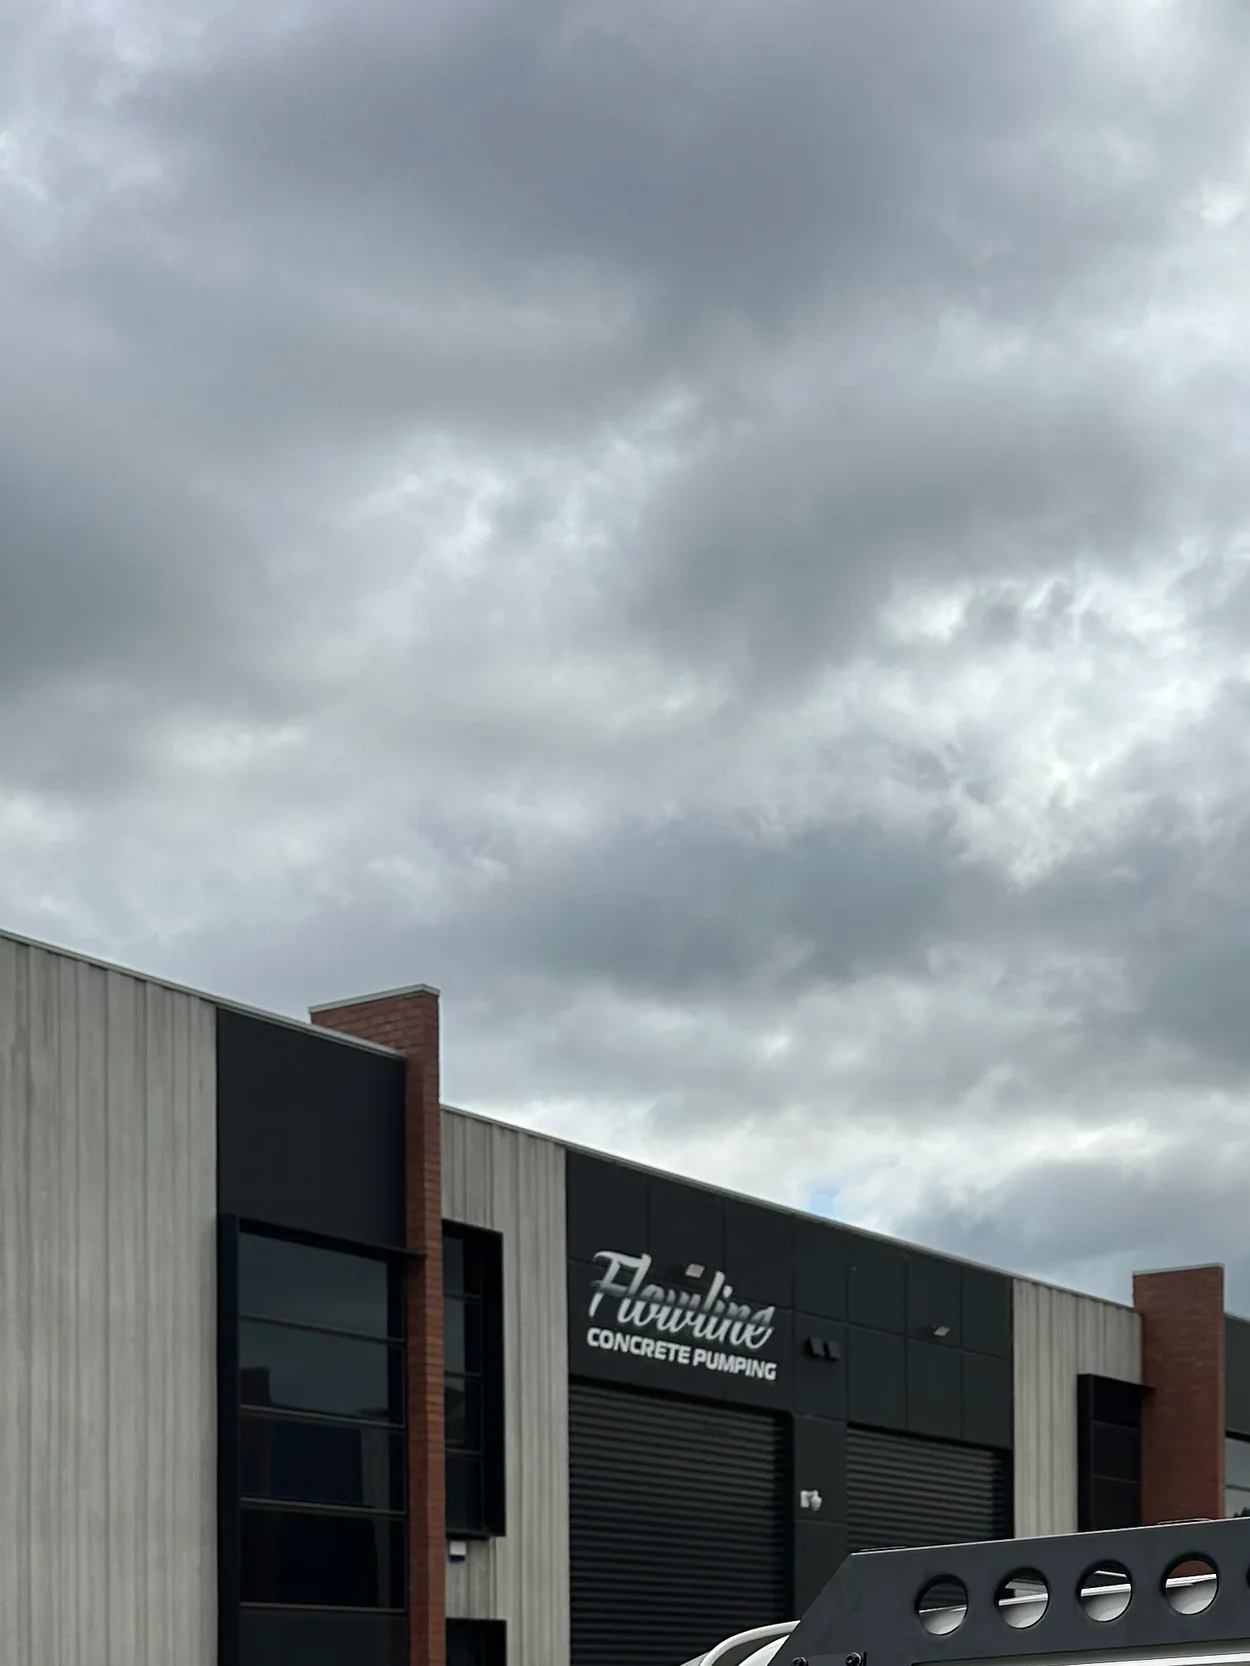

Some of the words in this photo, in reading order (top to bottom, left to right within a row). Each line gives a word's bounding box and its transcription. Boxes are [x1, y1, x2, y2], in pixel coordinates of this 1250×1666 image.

[589, 1250, 776, 1350] Flowline
[586, 1327, 692, 1365] CONCRETE
[692, 1349, 778, 1381] PUMPING
